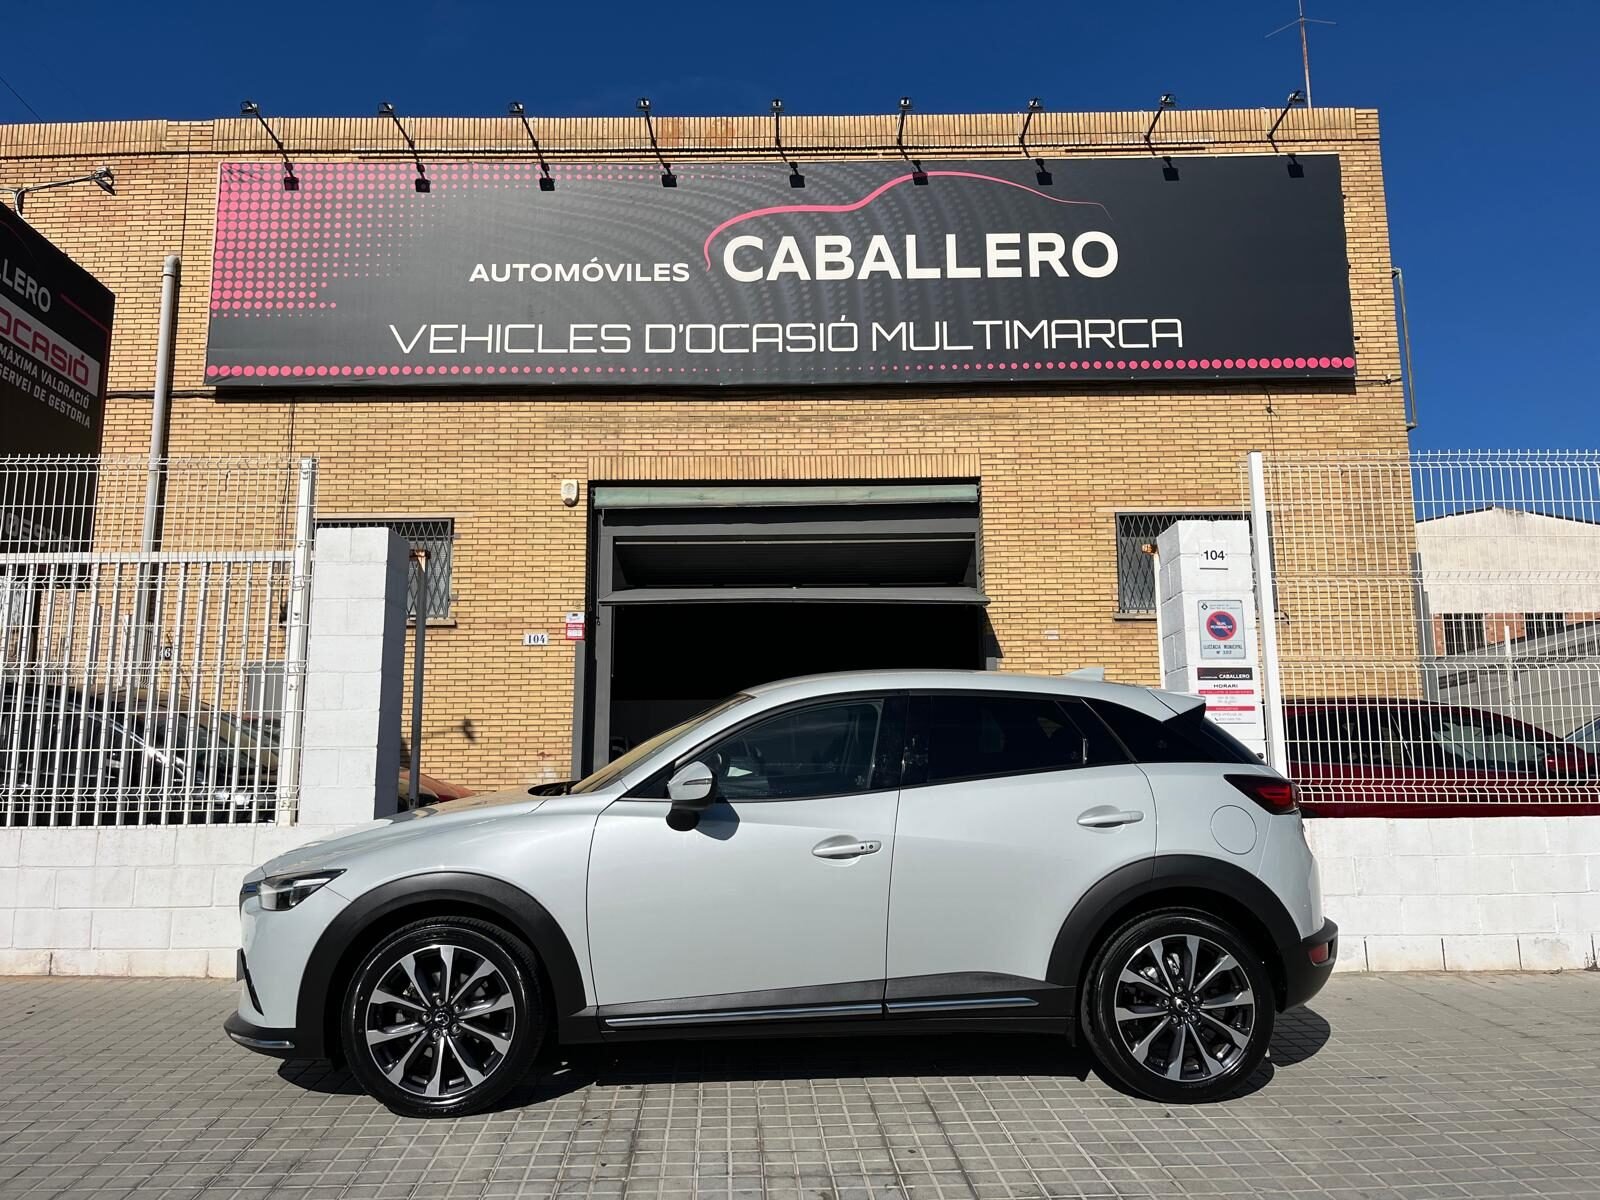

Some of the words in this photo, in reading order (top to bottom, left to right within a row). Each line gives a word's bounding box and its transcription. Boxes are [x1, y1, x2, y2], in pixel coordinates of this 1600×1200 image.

[468, 257, 690, 283] AUTOMÓVILES
[722, 230, 1119, 283] CABALLERO
[0, 257, 51, 312] LERO
[389, 323, 631, 355] VEHICLES
[644, 314, 858, 354] D'OCASIÓ
[872, 317, 1183, 352] MULTIMARCA
[33, 384, 47, 402] DE
[48, 394, 91, 429] GESTORIA
[41, 369, 90, 409] VALORACIÓ
[1203, 550, 1225, 561] 104
[528, 634, 545, 644] 104
